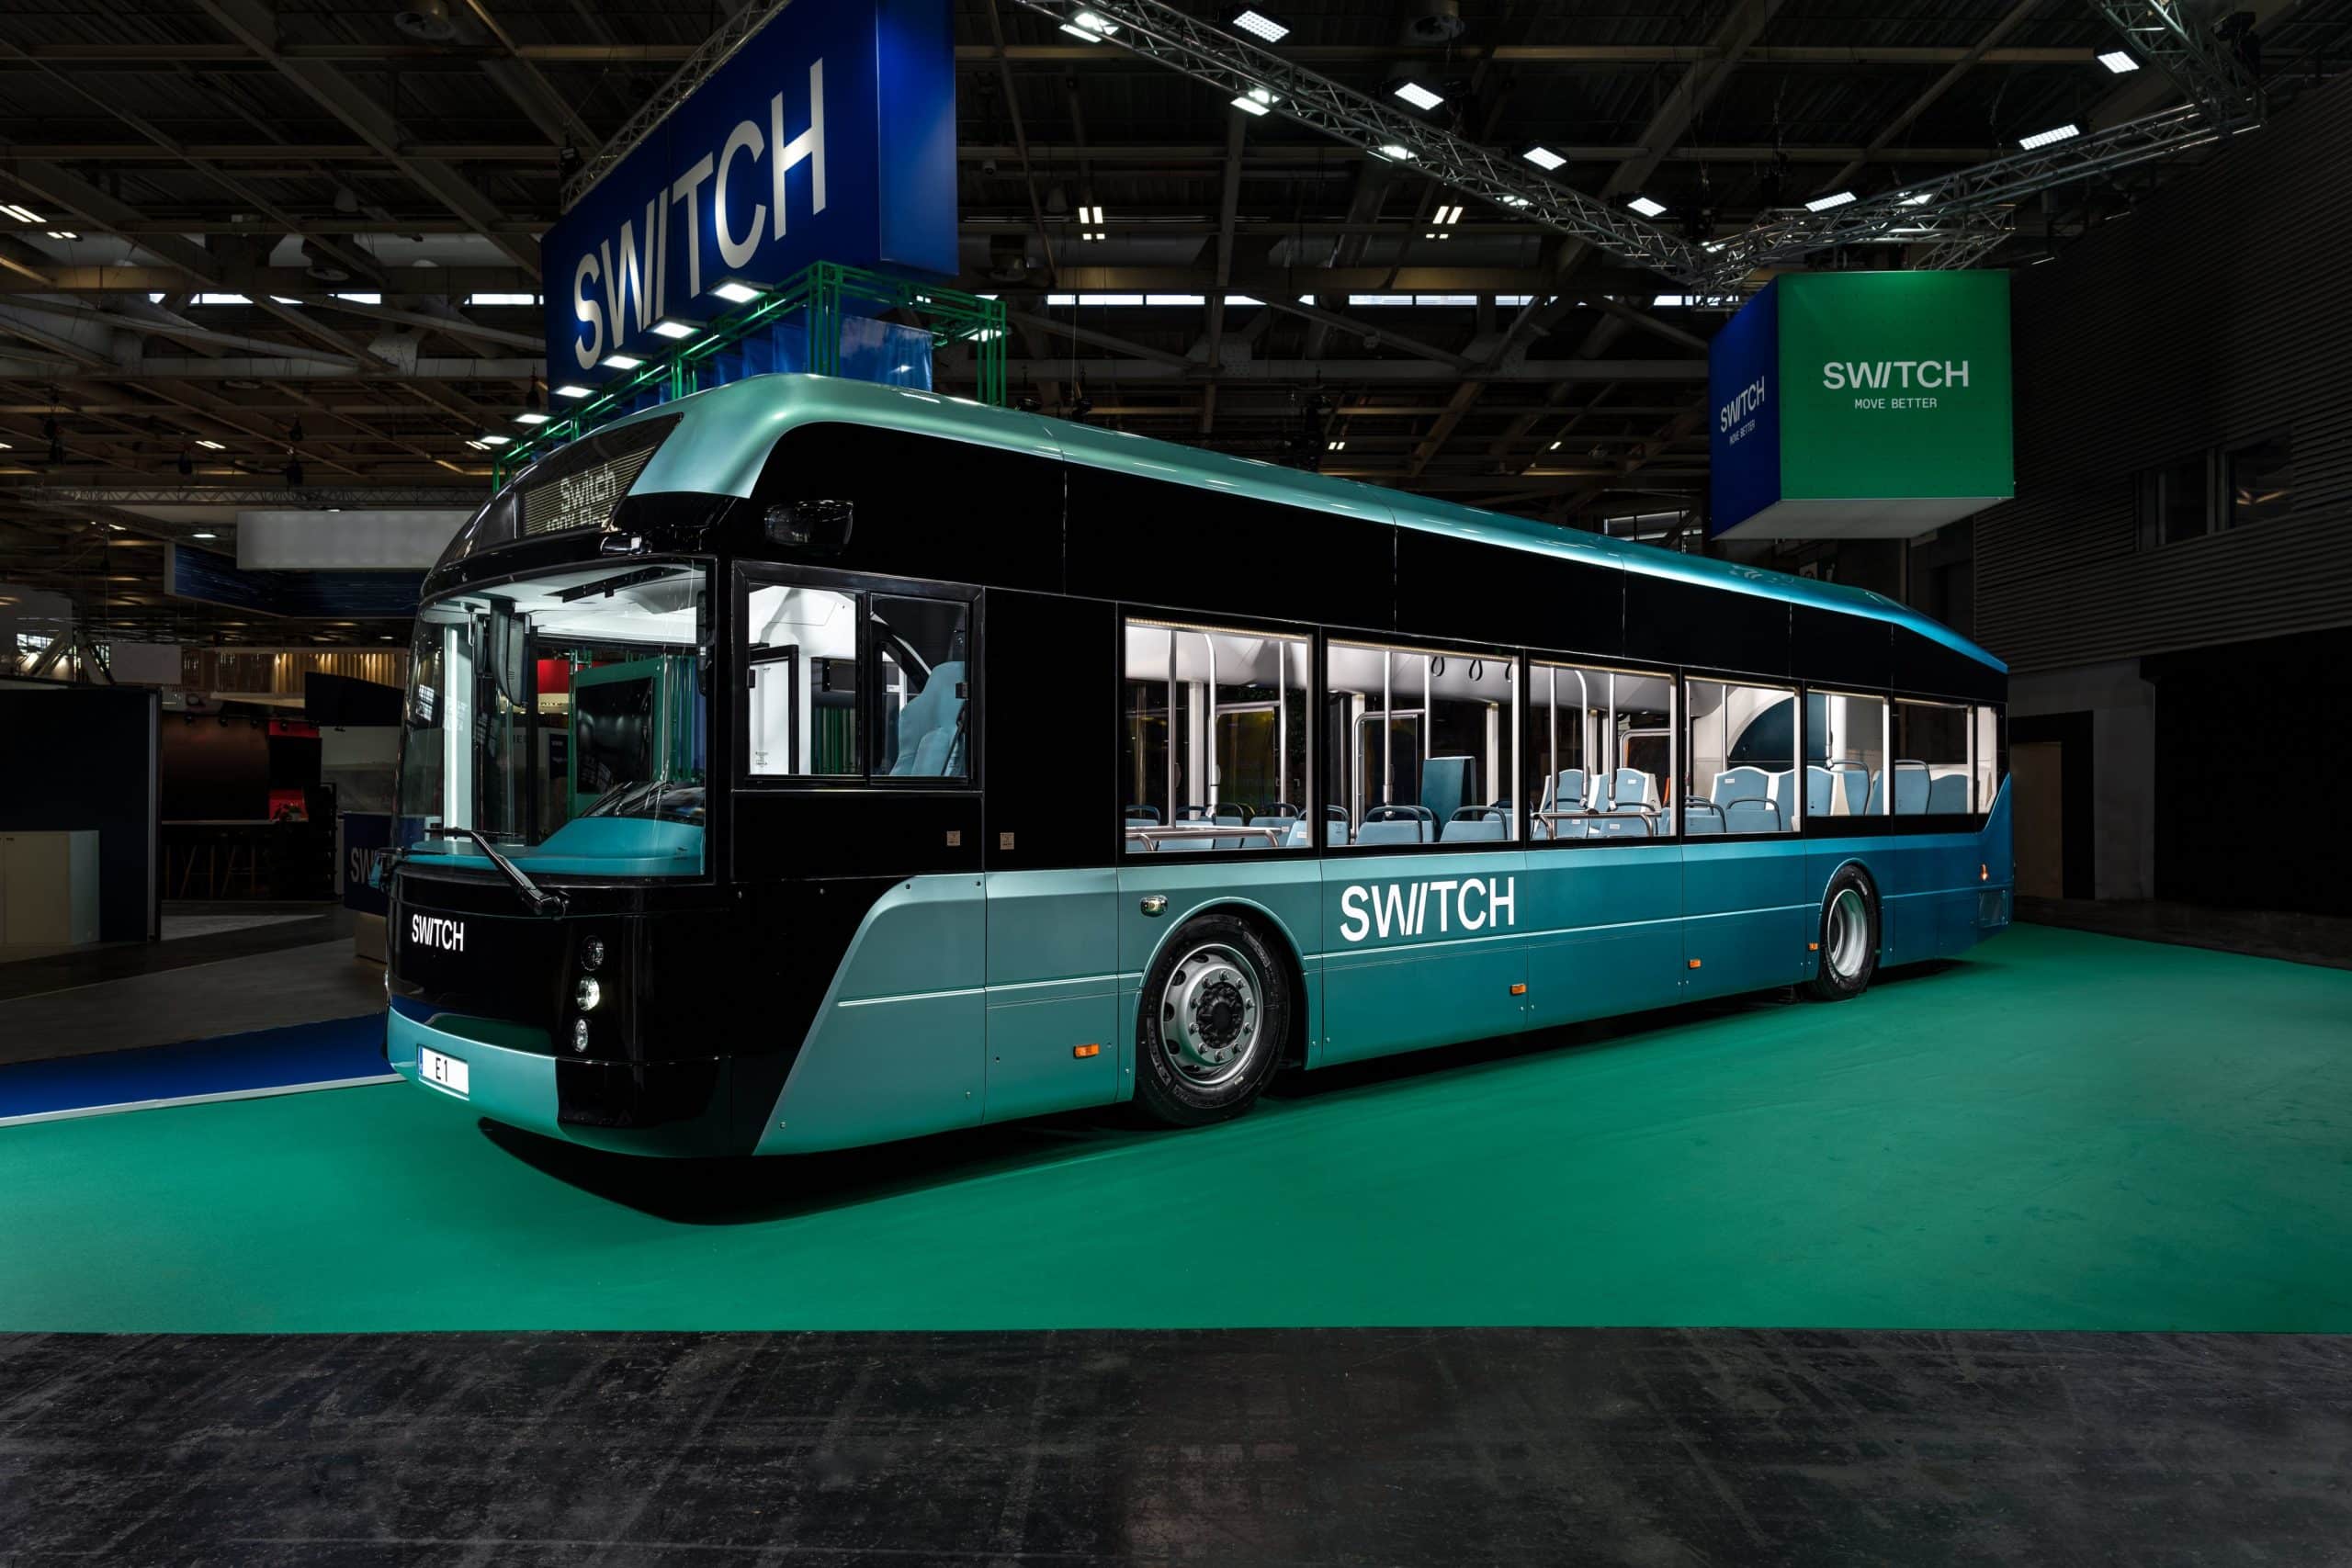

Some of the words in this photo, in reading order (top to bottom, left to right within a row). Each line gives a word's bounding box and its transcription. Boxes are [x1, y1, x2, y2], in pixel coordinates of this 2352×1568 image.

[573, 57, 826, 370] SWITCH
[1823, 360, 1970, 389] SWITCH
[1721, 376, 1765, 434] SWITCH
[1854, 398, 1885, 410] MOVE
[1891, 397, 1938, 410] BETTER
[560, 463, 616, 513] Switch
[412, 913, 465, 952] SWITCH
[1340, 876, 1515, 942] SWITCH
